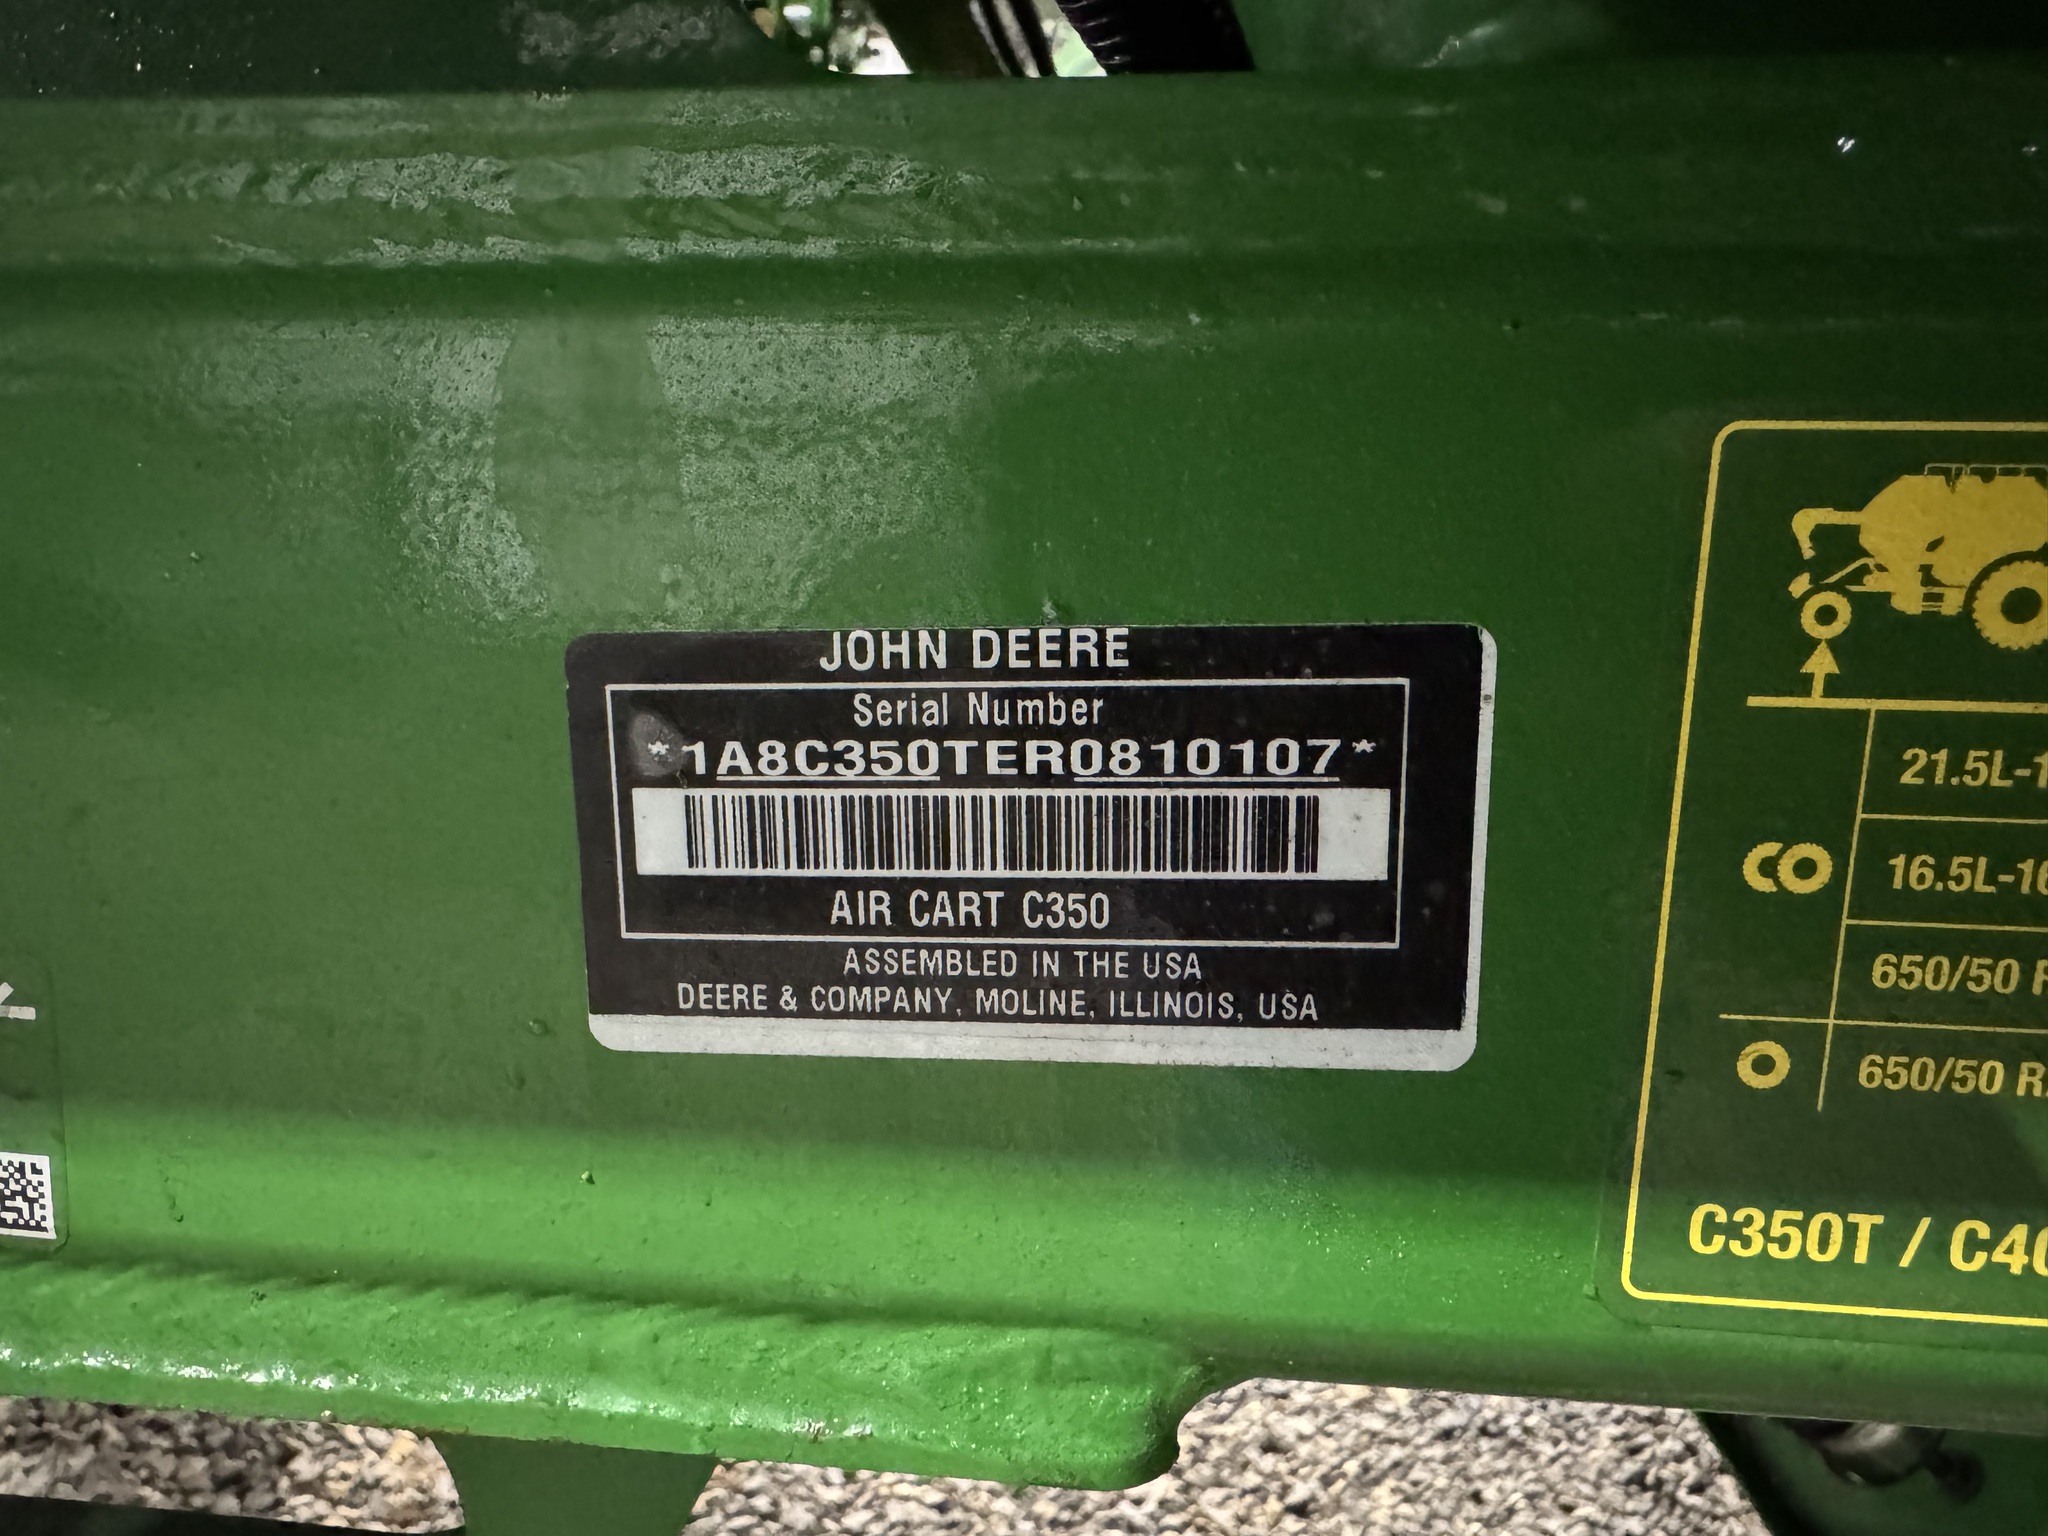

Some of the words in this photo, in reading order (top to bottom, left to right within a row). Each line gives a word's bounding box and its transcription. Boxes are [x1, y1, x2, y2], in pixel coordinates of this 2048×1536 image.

[819, 630, 948, 672] JOHN
[972, 628, 1130, 669] DEERE
[853, 692, 949, 728] Serial
[968, 691, 1105, 729] Number
[830, 889, 892, 926] AIR
[909, 889, 1005, 928] CART
[1022, 890, 1110, 930] C350
[842, 948, 1018, 978] ASSEMBLED
[1032, 950, 1060, 978] IN
[1073, 951, 1130, 979] THE
[1143, 952, 1202, 980] USA
[1871, 953, 2021, 994] 650/50
[677, 983, 768, 1010] DEERE
[780, 985, 798, 1012] &
[811, 986, 962, 1017] COMPANY,
[975, 988, 1096, 1020] MOLINE,
[1109, 990, 1244, 1022] ILLINOIS,
[1259, 992, 1319, 1021] USA
[1858, 1054, 2005, 1095] 650/50
[2016, 1061, 2048, 1098] R
[1689, 1203, 1884, 1265] C350T
[1899, 1216, 1932, 1267] /
